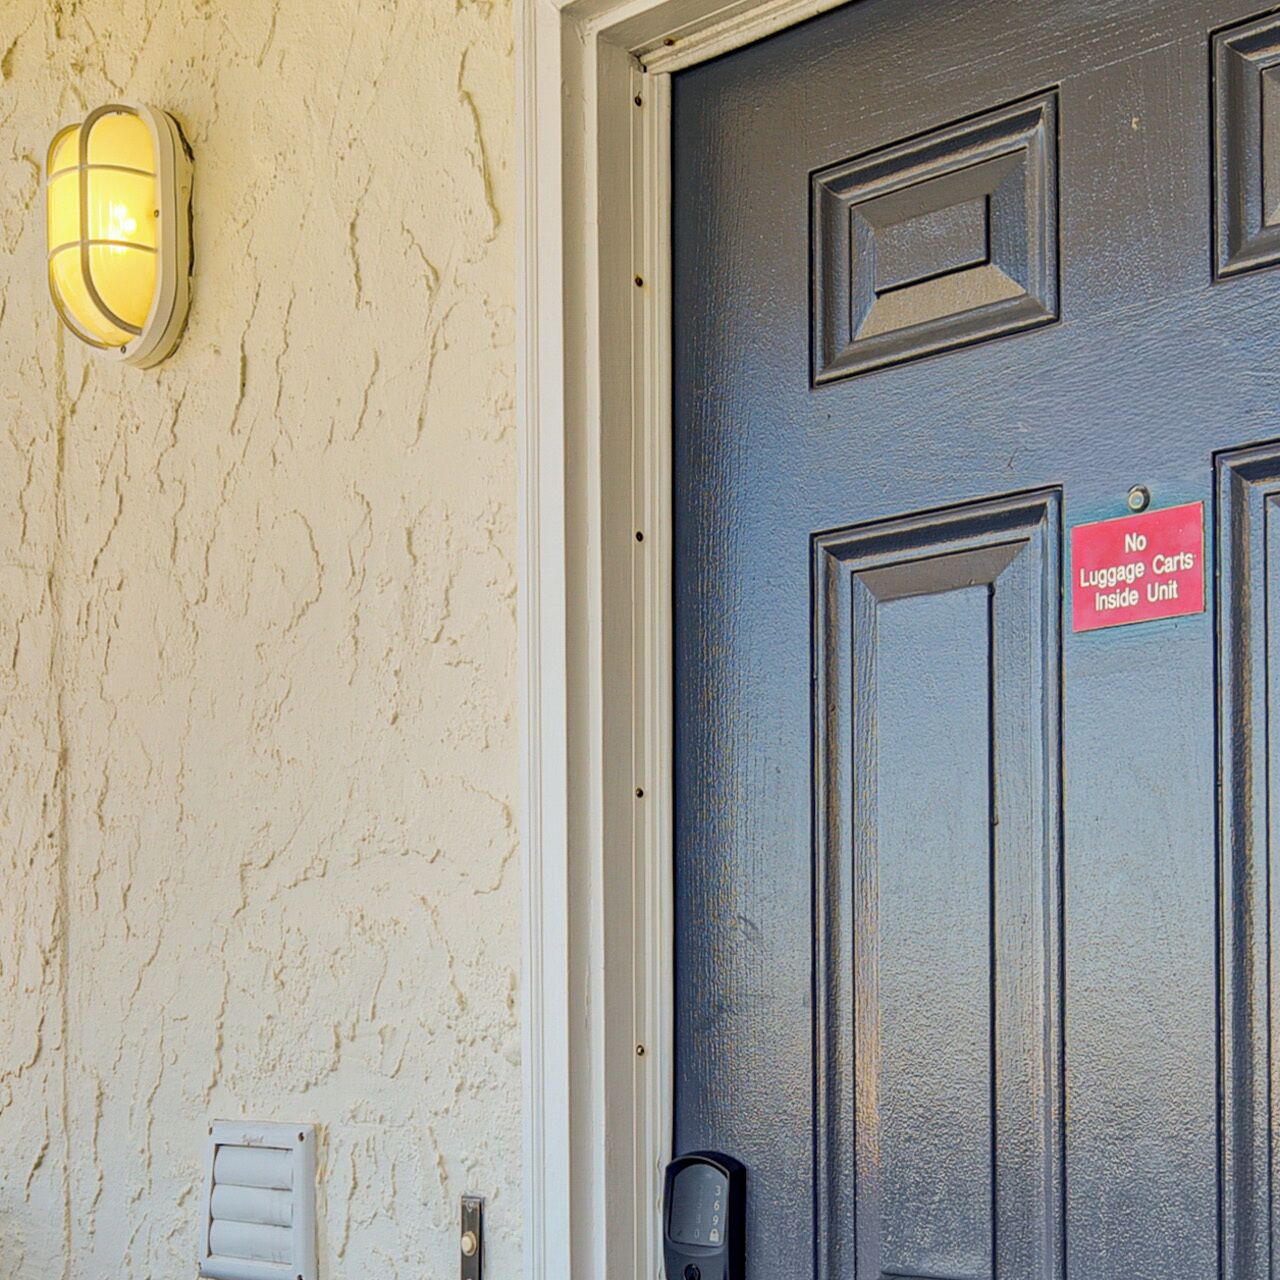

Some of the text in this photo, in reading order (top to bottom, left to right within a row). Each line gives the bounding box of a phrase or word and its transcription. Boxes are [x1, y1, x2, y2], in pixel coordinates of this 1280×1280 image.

[1124, 532, 1147, 553] No
[1080, 552, 1194, 588] Luggage Carts
[1095, 580, 1178, 611] Inside Unit
[714, 1185, 721, 1196] 3
[713, 1200, 720, 1211] 6
[712, 1215, 719, 1226] 9
